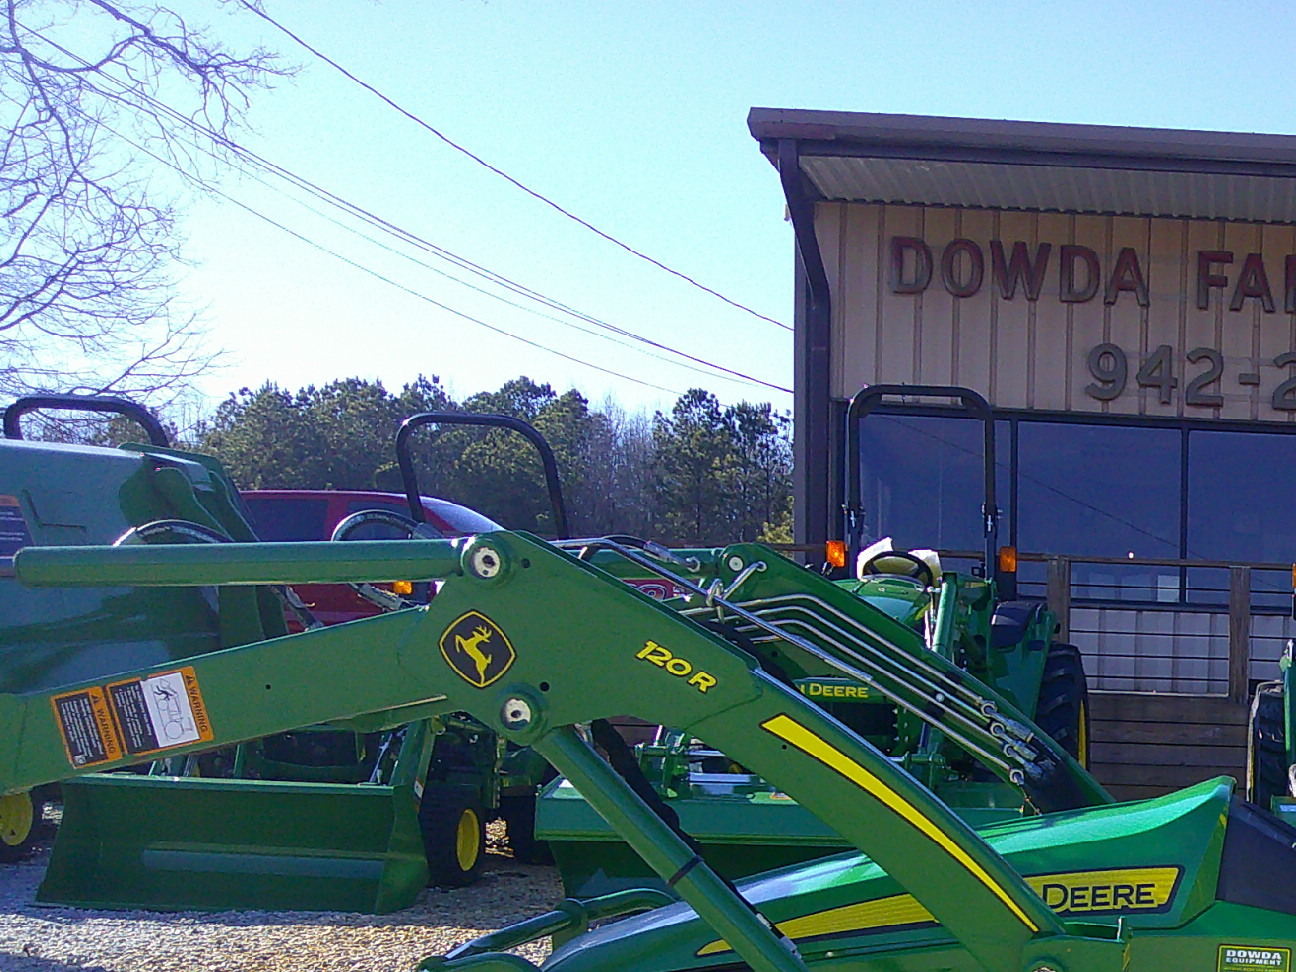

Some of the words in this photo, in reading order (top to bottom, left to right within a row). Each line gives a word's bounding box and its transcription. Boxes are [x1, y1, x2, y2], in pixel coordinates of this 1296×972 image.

[890, 237, 1150, 306] DOWDA
[809, 683, 869, 698] DEERE
[188, 686, 208, 732] WARNING
[1042, 883, 1156, 909] DEERE
[1225, 957, 1282, 966] EQUIPMENT
[1226, 949, 1282, 960] DOWDA
